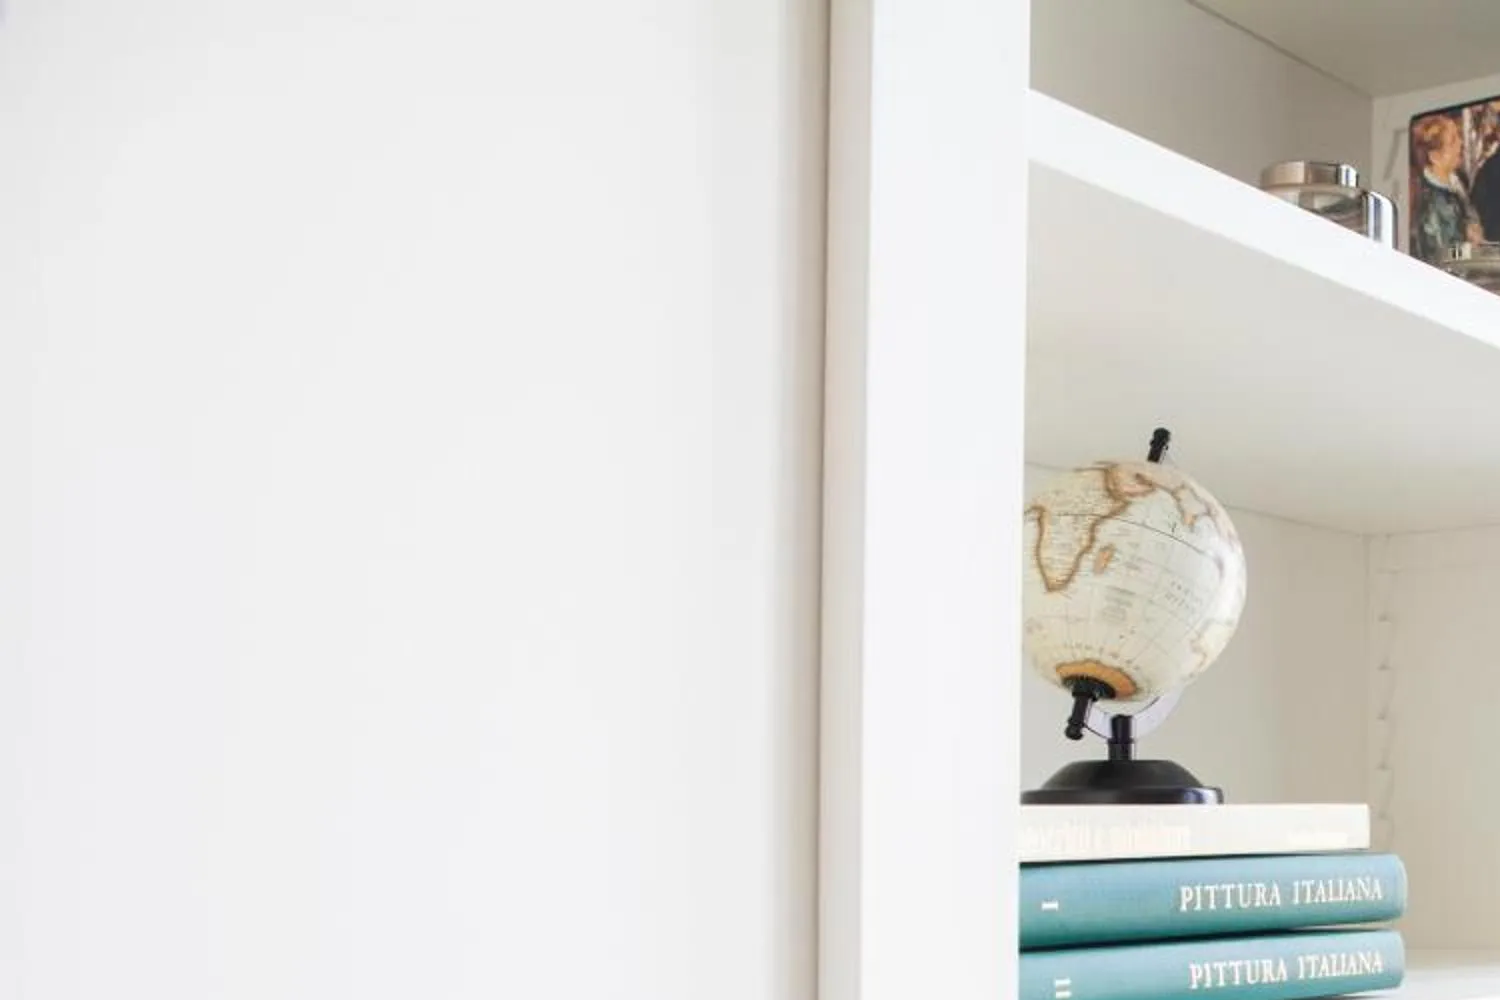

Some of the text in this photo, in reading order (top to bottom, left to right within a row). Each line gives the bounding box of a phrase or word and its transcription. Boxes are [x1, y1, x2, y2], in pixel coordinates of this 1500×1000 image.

[1180, 877, 1383, 911] PITTURA ITALIANA
[1189, 951, 1384, 989] PITTURA ITALIANA
